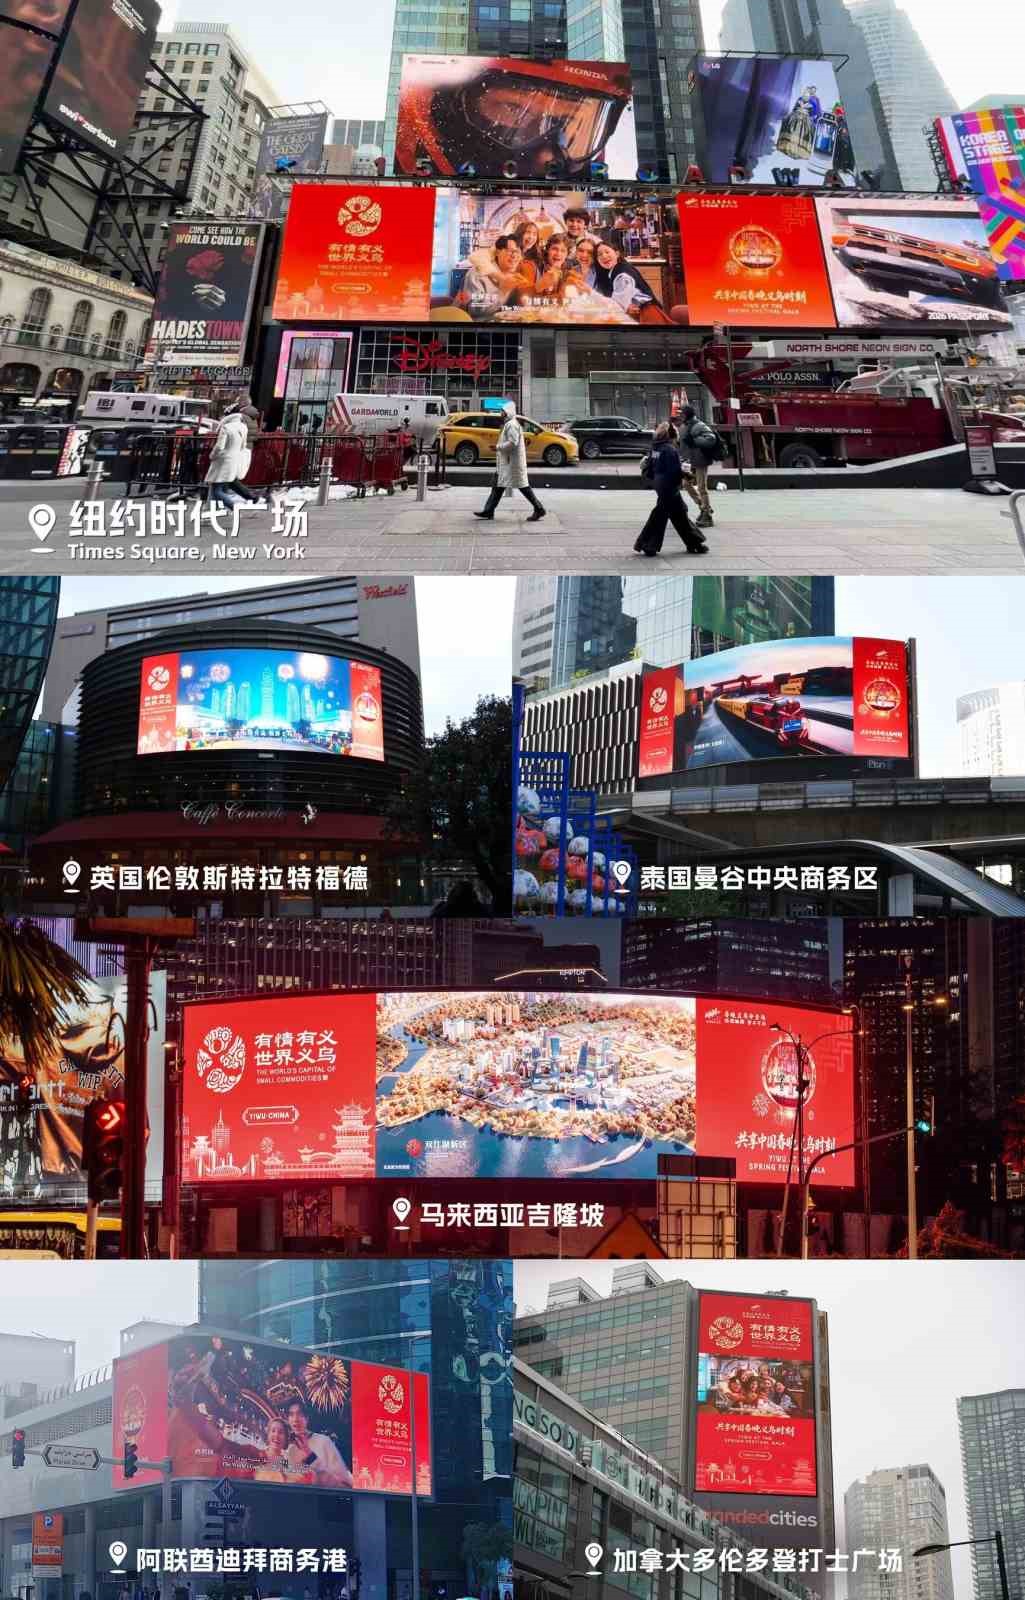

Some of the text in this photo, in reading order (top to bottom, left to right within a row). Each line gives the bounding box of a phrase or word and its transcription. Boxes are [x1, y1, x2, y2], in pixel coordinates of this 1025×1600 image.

[564, 65, 609, 81] HONDA
[959, 129, 1008, 148] KOREA
[962, 143, 1013, 160] STAGE
[207, 226, 219, 234] SEE
[175, 234, 256, 247] WORLD COULD BE
[947, 312, 991, 320] PASSPORT
[786, 344, 822, 352] NORTH
[824, 344, 859, 352] SHORE
[861, 344, 890, 352] NEON
[892, 344, 917, 353] SIGN
[767, 372, 792, 381] POLO
[351, 407, 399, 417] GARDAWORLD
[254, 1030, 338, 1049] 有情有义
[254, 1046, 336, 1066] 世界义乌
